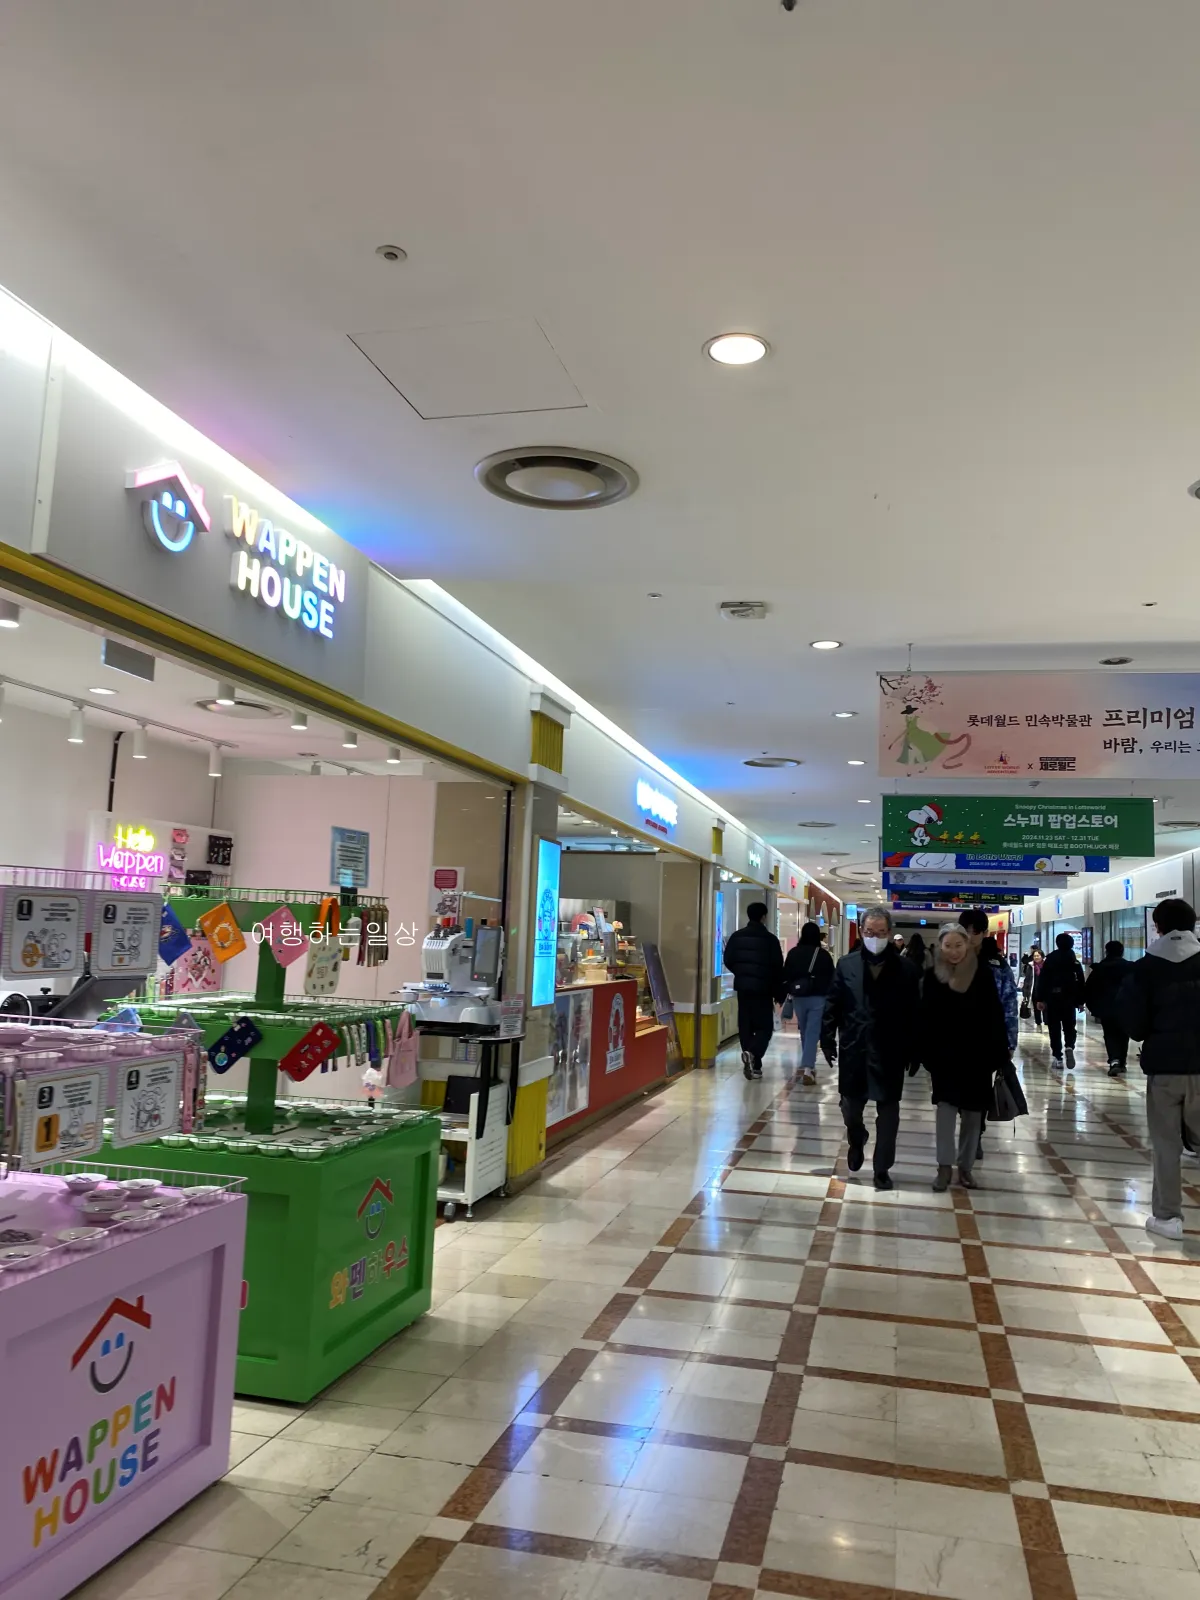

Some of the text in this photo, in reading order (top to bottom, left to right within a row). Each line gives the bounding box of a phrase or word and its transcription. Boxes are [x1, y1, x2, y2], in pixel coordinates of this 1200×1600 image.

[226, 494, 346, 603] WAPPEN
[233, 550, 335, 639] HOUSE
[966, 706, 1195, 730] 롯데월드 민속박물관 프리미엄
[1039, 761, 1076, 771] 제로월드
[1103, 736, 1143, 755] 바람,
[1150, 740, 1192, 754] 우리는
[1003, 813, 1118, 829] 스누피 팝업스토어
[97, 844, 165, 875] Wappen
[329, 1235, 409, 1309] 와펜하우스
[22, 1376, 176, 1505] WAPPEN
[33, 1428, 161, 1548] HOUSE
